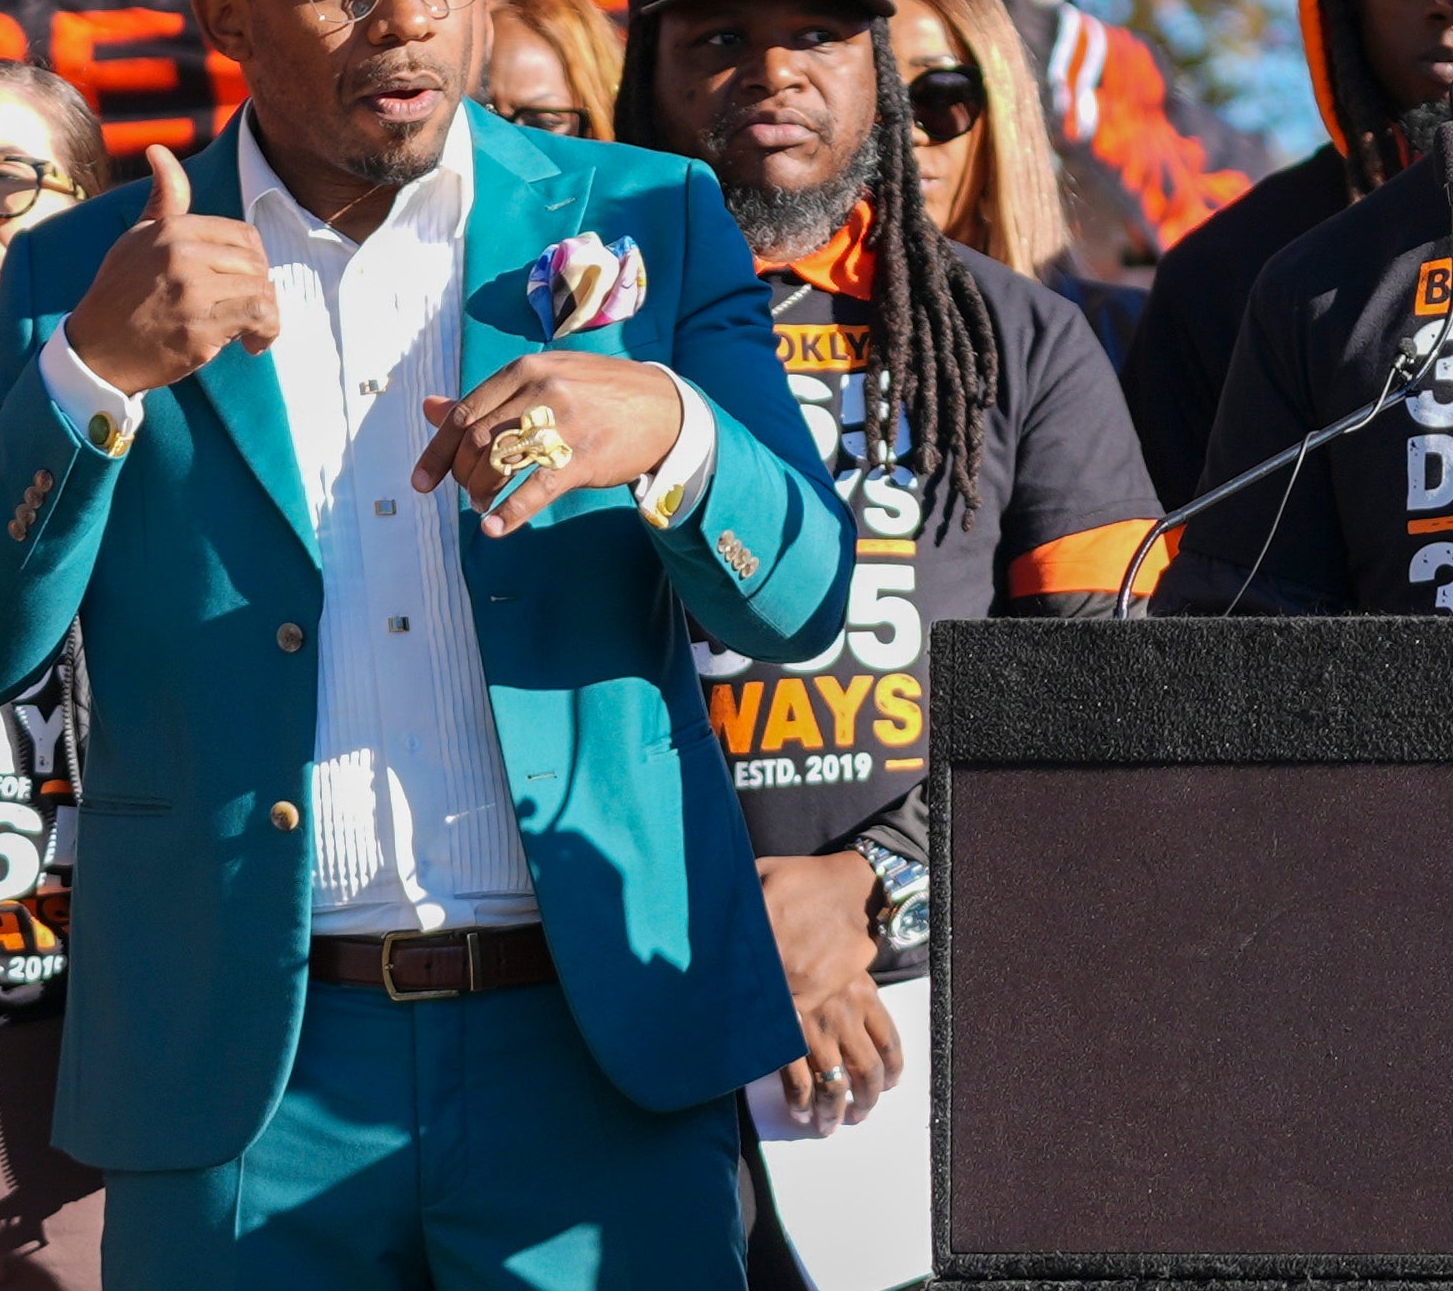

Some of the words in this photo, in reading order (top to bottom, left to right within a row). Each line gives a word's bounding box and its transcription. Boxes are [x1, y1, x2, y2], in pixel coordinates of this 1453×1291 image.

[711, 673, 924, 754] WAYS
[735, 756, 801, 789] ESTD.
[805, 752, 873, 783] 2019
